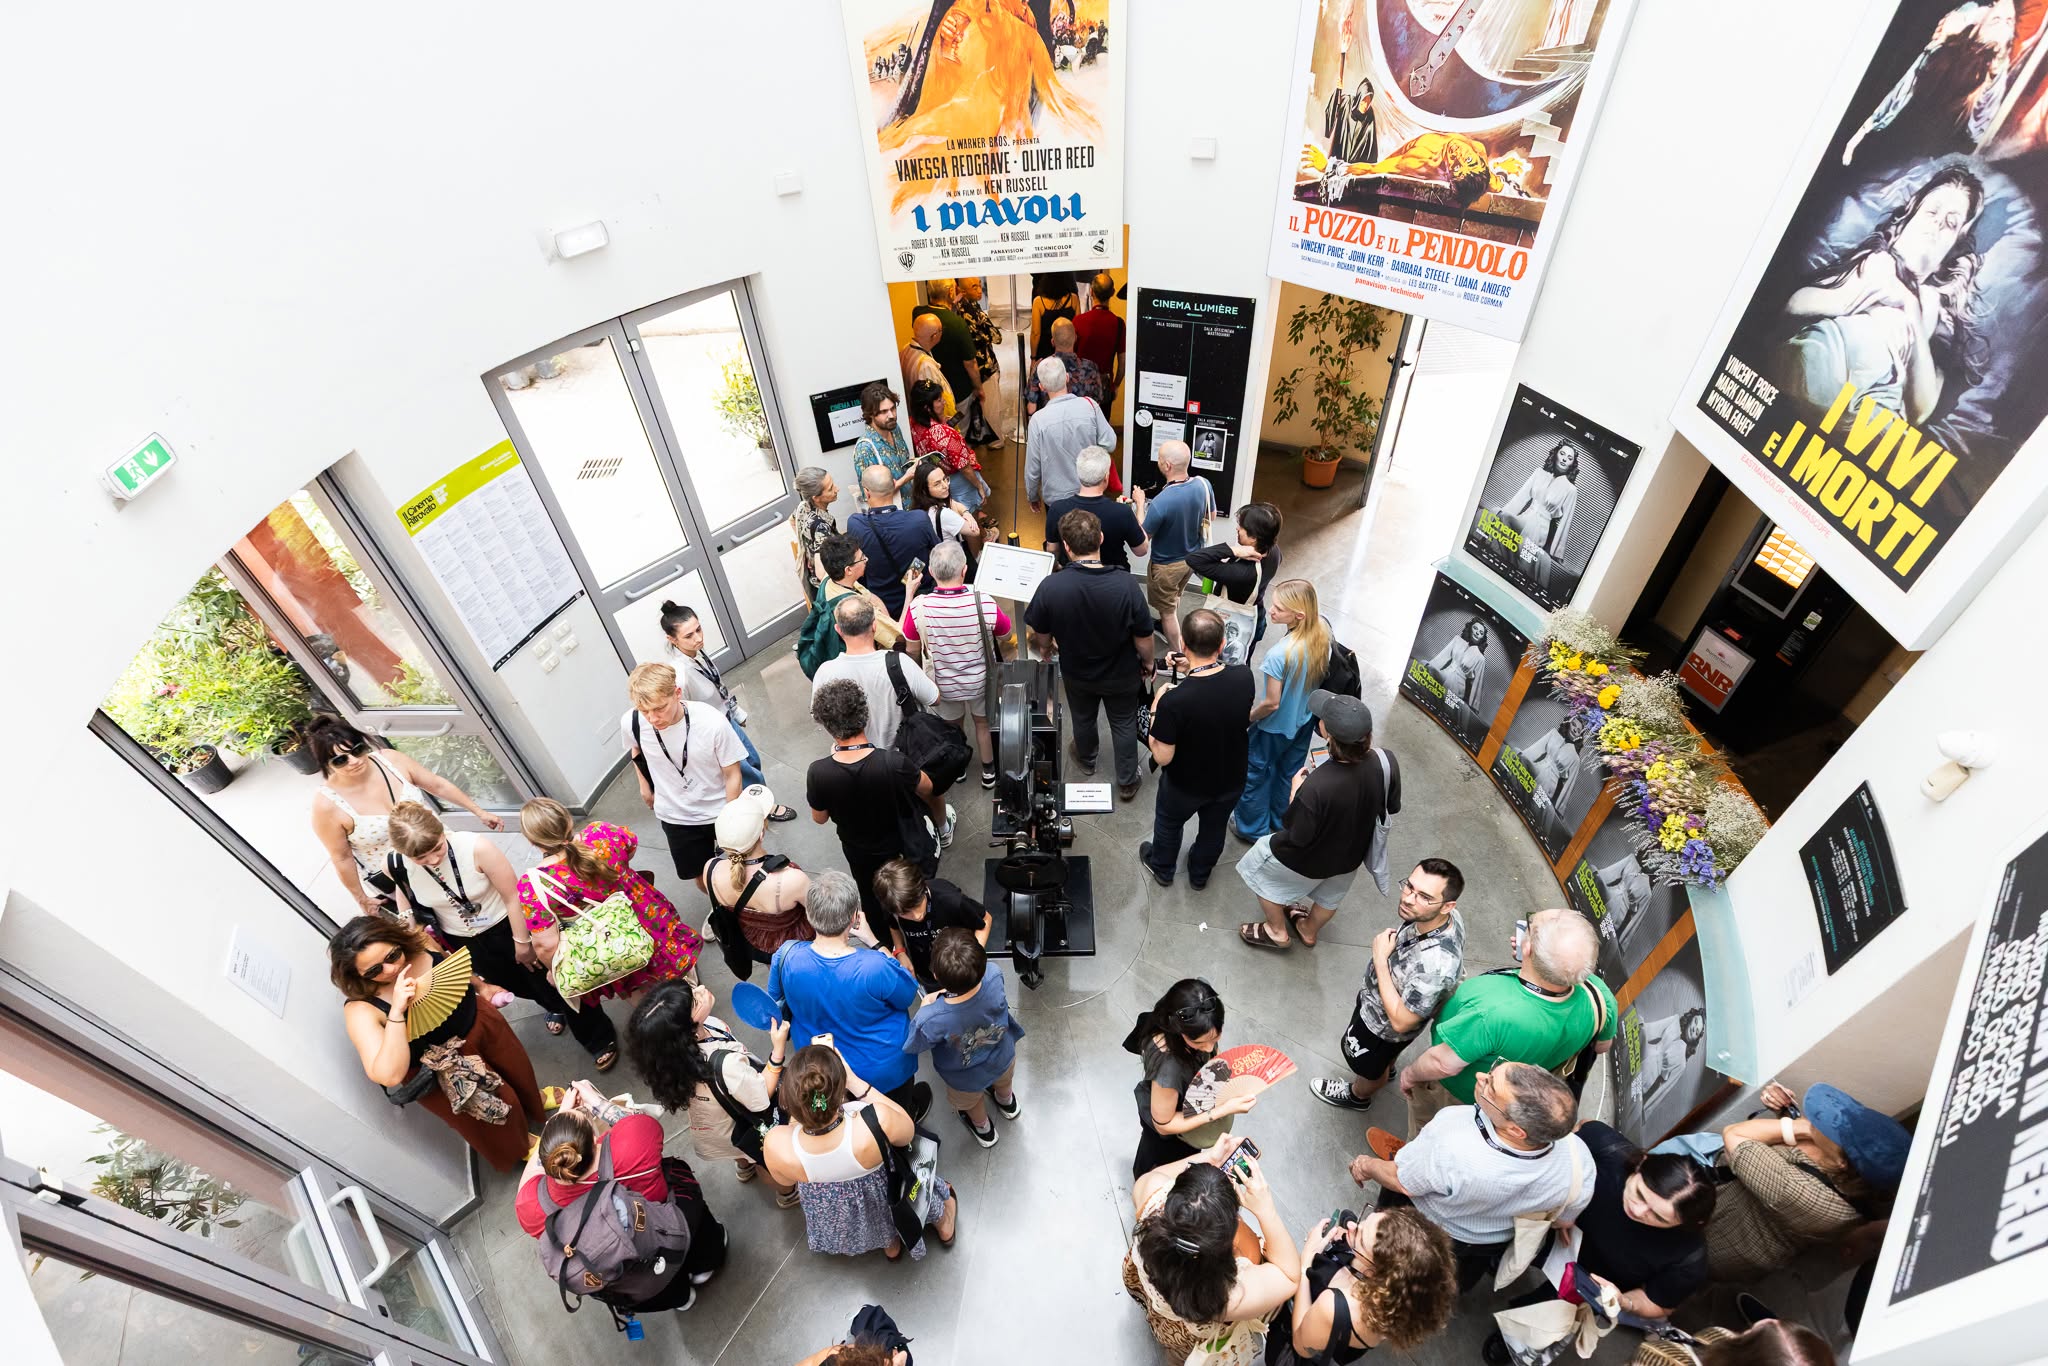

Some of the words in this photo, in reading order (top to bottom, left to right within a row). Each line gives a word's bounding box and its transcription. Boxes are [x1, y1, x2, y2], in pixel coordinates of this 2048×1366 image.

[946, 140, 955, 150] LA
[957, 138, 986, 149] WARNER
[989, 136, 1010, 148] BROS.
[895, 156, 948, 182] VANESSA
[952, 152, 1010, 177] REDGRAVE
[1022, 148, 1062, 172] OLIVER
[1066, 146, 1095, 169] REED
[984, 179, 1002, 194] KEN
[1006, 176, 1048, 193] RUSSELL
[912, 205, 931, 232] I
[937, 192, 1086, 231] DIAVOLI
[911, 238, 928, 249] ROBERT
[949, 236, 958, 246] KEN
[960, 235, 979, 245] RUSSELL
[941, 249, 950, 258] KEN
[952, 247, 970, 257] RUSSELL
[1000, 232, 1009, 242] KEN
[1010, 230, 1030, 241] RUSSELL
[1288, 216, 1300, 232] IL
[1302, 206, 1376, 246] POZZO
[1375, 234, 1384, 250] E
[1388, 237, 1401, 254] IL
[1401, 228, 1528, 280] PENDOLO
[1300, 239, 1326, 255] VINCENT
[1327, 245, 1345, 259] PRICE
[1348, 250, 1365, 263] JOHN
[1367, 254, 1384, 268] KERR
[1391, 259, 1422, 278] BARBARA
[1425, 268, 1450, 284] STEELE
[1454, 274, 1478, 291] LUANA
[1481, 281, 1511, 298] ANDERS
[1337, 261, 1356, 272] RICHARD
[1356, 265, 1380, 278] MATHESON
[1409, 279, 1418, 287] LES
[1419, 280, 1437, 292] BAXTER
[1463, 292, 1479, 302] ROGER
[1480, 295, 1503, 308] CORMAN
[1355, 277, 1387, 290] panavision
[1390, 287, 1425, 300] technicolor
[1152, 299, 1191, 310] CINEMA
[1194, 303, 1238, 315] LUMIÈRE
[1715, 373, 1740, 400] MARK
[1734, 388, 1765, 421] DAMON
[1725, 354, 1759, 388] VINCENT
[1752, 377, 1780, 406] PRICE
[1706, 389, 1734, 421] MYRNA
[1729, 409, 1756, 438] FAHEY
[1761, 431, 1782, 458] E
[1773, 420, 1807, 468] I
[1819, 381, 1857, 434] I
[1844, 395, 1958, 508] VIVI
[407, 495, 434, 516] Cinema
[407, 503, 436, 527] Ritrovato
[1740, 453, 1786, 497] EASTMANCOLOR
[1787, 490, 1832, 539] CINEMASCOPE
[1789, 434, 1938, 576] MORTI
[1478, 520, 1518, 552] Ritrovato
[1488, 513, 1523, 544] Cinema
[1409, 668, 1442, 698] Ritrovato
[1418, 664, 1446, 694] Cinema
[1502, 754, 1532, 793] Ritrovato
[1510, 752, 1537, 789] Cinema
[1577, 870, 1600, 919] Ritrovato
[1585, 868, 1606, 915] Cinema
[1991, 940, 2021, 1013] ORAZIO
[2008, 932, 2037, 1001] MARIO
[1964, 942, 2006, 1061] FRANCESCO
[1232, 1048, 1264, 1069] GARDEN
[1235, 1065, 1244, 1075] OF
[1245, 1054, 1266, 1069] EDEN
[1962, 1017, 2001, 1125] ORLANDO
[1982, 1003, 2021, 1107] SCACCIA
[1995, 998, 2038, 1119] BONUGLIA
[1941, 1064, 1975, 1148] BARILLI
